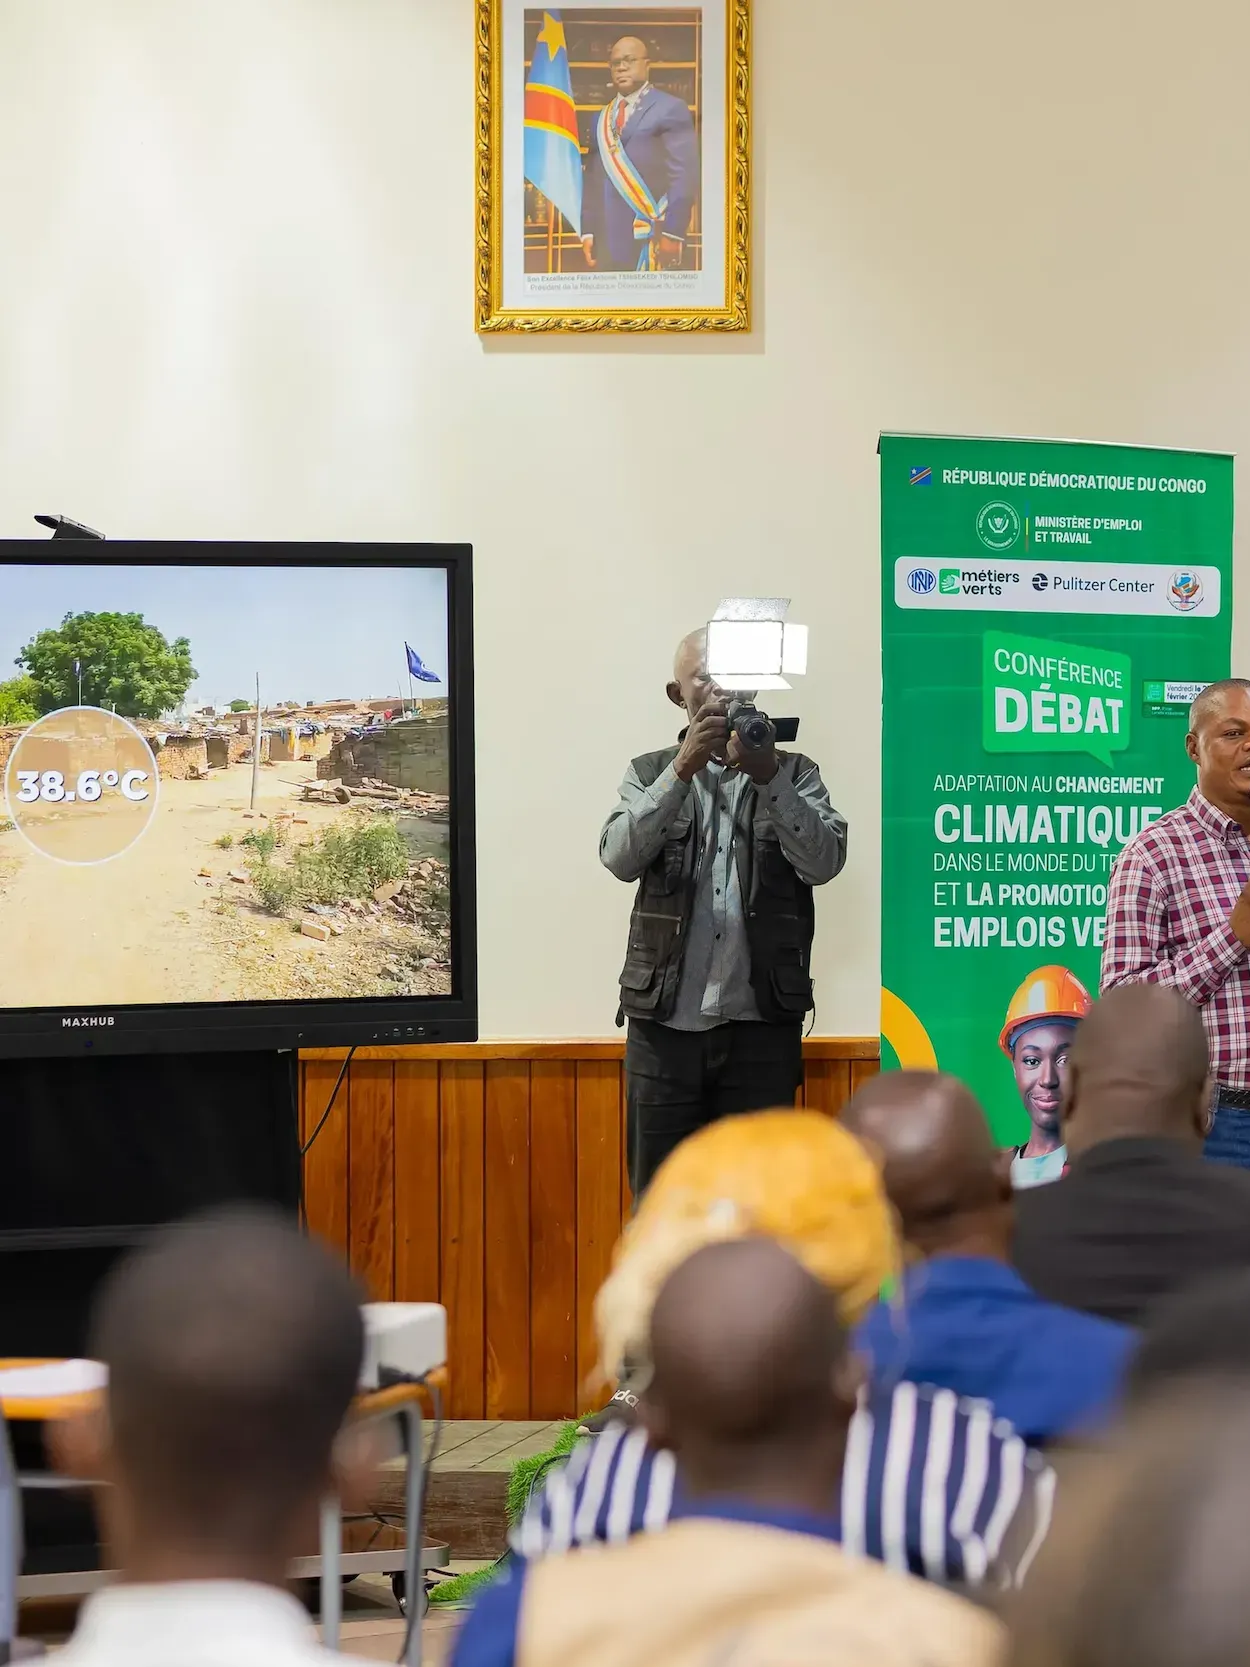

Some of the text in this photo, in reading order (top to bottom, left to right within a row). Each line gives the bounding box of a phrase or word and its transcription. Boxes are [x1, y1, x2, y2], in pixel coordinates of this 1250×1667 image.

[943, 467, 1207, 494] RÉPUBLIQUE DÉMOCRATIQUE DU CONGO
[1034, 515, 1092, 529] MINISTÈRE
[1093, 518, 1143, 531] D'EMPLOI
[1034, 531, 1092, 544] ET TRAVAIL
[961, 569, 1020, 583] métiers
[1053, 576, 1155, 593] Pulitzer Center
[962, 583, 1002, 596] verts
[994, 648, 1123, 689] CONFÉRENCE
[1166, 684, 1194, 692] Vendredi
[1194, 684, 1202, 692] le
[1166, 692, 1188, 700] février
[995, 682, 1124, 734] DÉBAT
[16, 769, 149, 802] 38.6°C
[933, 774, 1165, 794] ADAPTATION AU CHANGEMENT
[933, 852, 982, 872] DANS
[985, 853, 1004, 872] LE
[1008, 853, 1069, 872] MONDE
[1072, 854, 1096, 872] DU
[934, 882, 1107, 906] ET LA PROMOTIO
[934, 916, 1066, 948] EMPLOIS
[61, 1016, 115, 1027] MAXHUB
